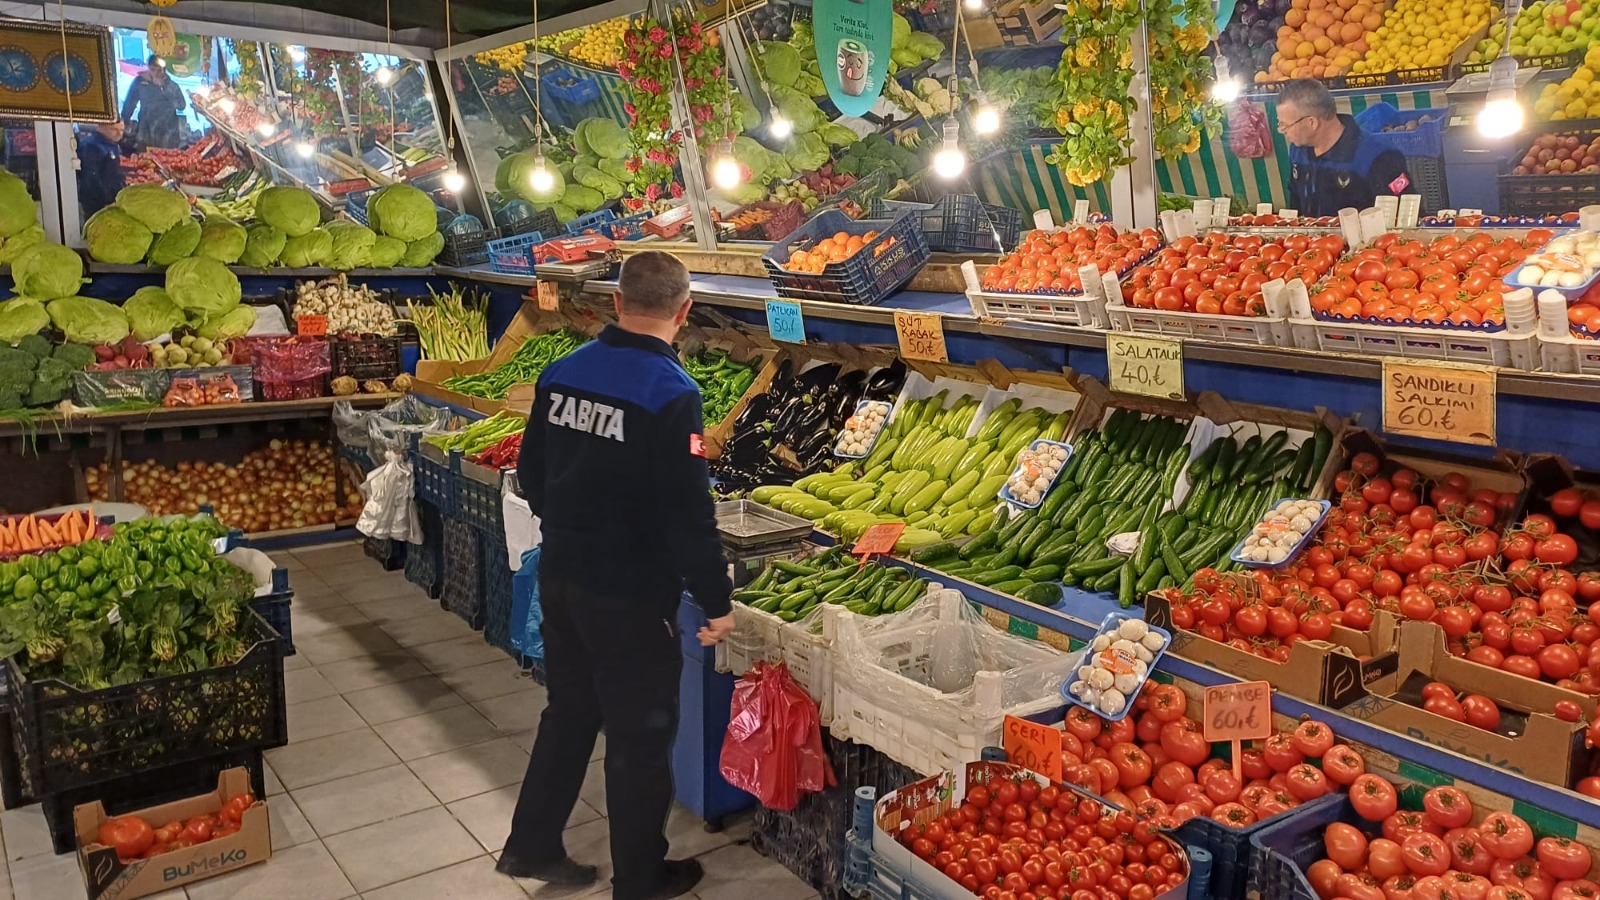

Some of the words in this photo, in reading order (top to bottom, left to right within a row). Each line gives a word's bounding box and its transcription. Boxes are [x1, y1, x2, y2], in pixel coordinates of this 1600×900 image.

[833, 23, 844, 32] Tam
[1392, 372, 1475, 396] SANDIKLI
[1393, 391, 1475, 411] SALKIMI
[547, 392, 625, 443] ZABITA
[1208, 687, 1264, 704] PEMBE
